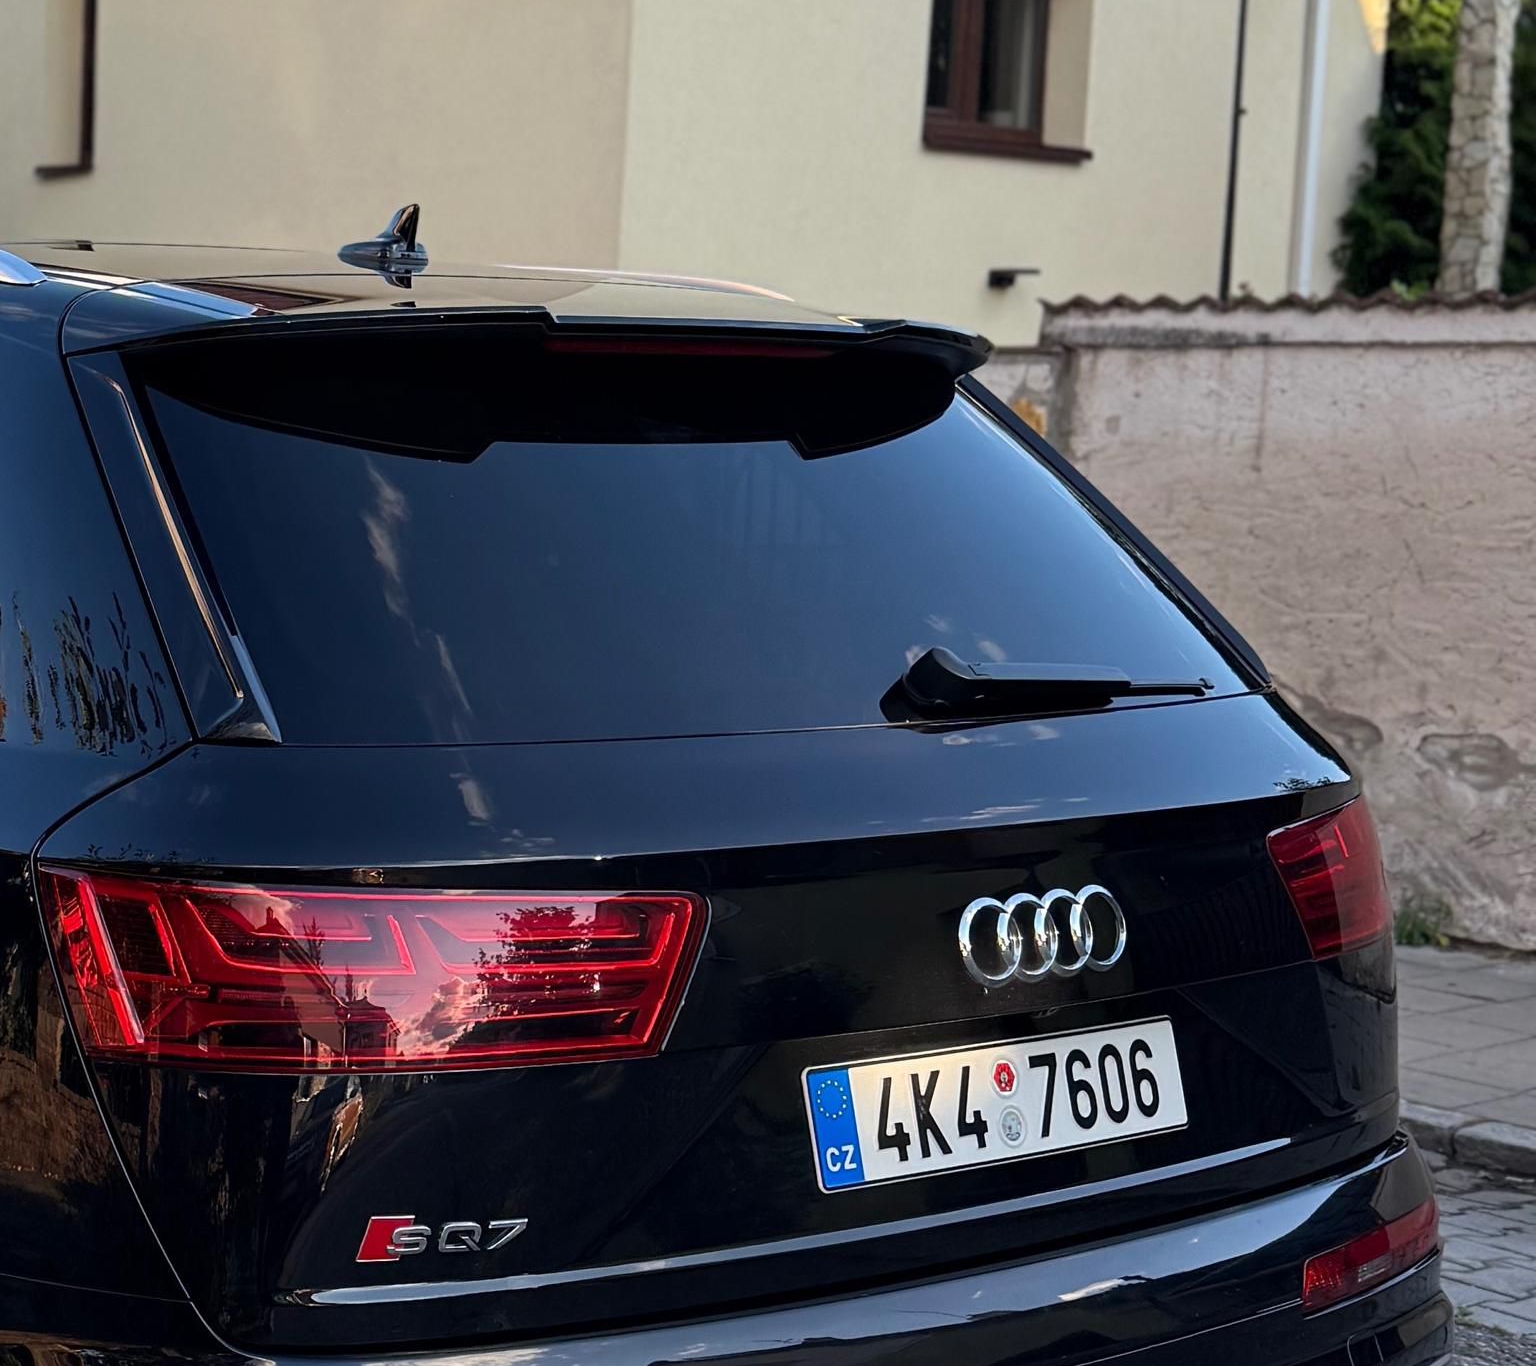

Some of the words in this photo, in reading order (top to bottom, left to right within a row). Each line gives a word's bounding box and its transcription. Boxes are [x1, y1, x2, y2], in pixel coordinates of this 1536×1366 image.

[877, 1065, 988, 1162] 4K4
[1028, 1038, 1160, 1138] 7606
[825, 1144, 858, 1174] CZ
[386, 1217, 529, 1255] SQ7
